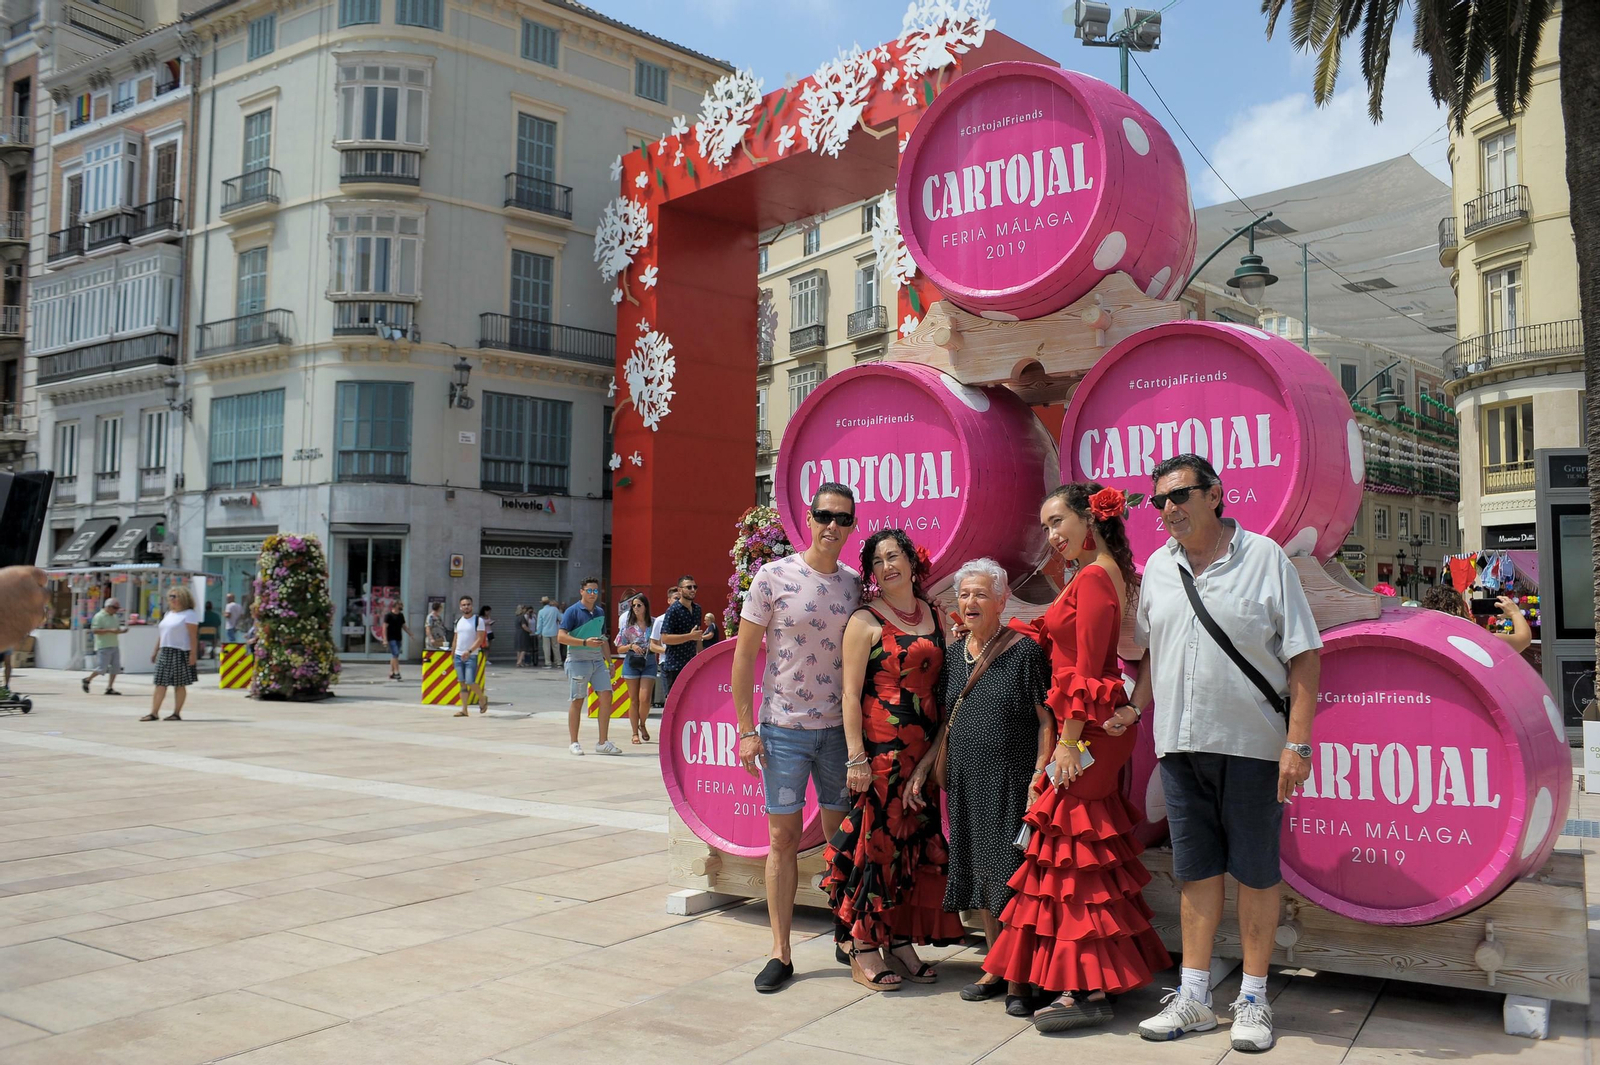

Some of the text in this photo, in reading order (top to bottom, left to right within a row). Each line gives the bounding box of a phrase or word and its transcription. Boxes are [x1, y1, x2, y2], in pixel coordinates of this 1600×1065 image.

[960, 109, 1043, 136] #CartojalFriends
[922, 142, 1093, 221] CARTOJAL
[942, 211, 1073, 248] FERIA MÁLAGA
[986, 240, 1026, 259] 2019
[1129, 370, 1227, 389] #CartojalFriends
[836, 413, 914, 428] #CartojalFriends
[1079, 413, 1281, 480] CARTOJAL
[1563, 464, 1588, 473] Grup
[800, 450, 960, 508] CARTOJAL
[501, 497, 543, 511] helvetia
[484, 544, 564, 558] women'secret
[1317, 692, 1432, 706] #CartojalFriends
[1291, 742, 1500, 813] RTOJAL
[697, 780, 735, 795] FERIA
[734, 802, 766, 817] 2019
[1290, 817, 1472, 845] FERIA MÁLAGA
[1351, 847, 1406, 865] 2019
